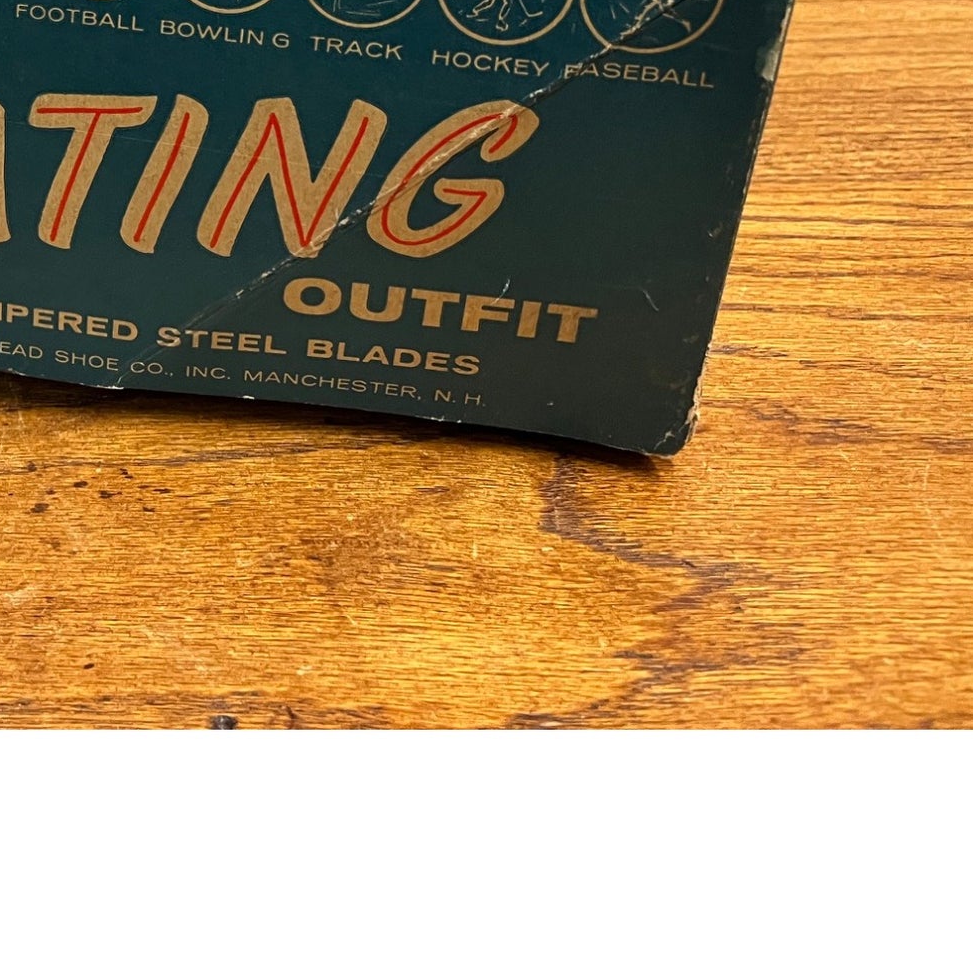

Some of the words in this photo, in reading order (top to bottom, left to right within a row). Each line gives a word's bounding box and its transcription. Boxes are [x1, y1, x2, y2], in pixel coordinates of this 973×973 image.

[15, 3, 145, 33] FOOTBALL
[160, 19, 291, 49] BOWLING
[310, 35, 404, 61] TRACK
[431, 49, 550, 78] HOCKEY
[283, 277, 599, 344] OUTFIT
[157, 326, 287, 356] STEEL
[306, 339, 481, 376] BLADES
[54, 350, 120, 372] SHOE
[129, 360, 174, 377] CO.,
[185, 365, 232, 380] INC.
[243, 369, 423, 402] MANCHESTER,
